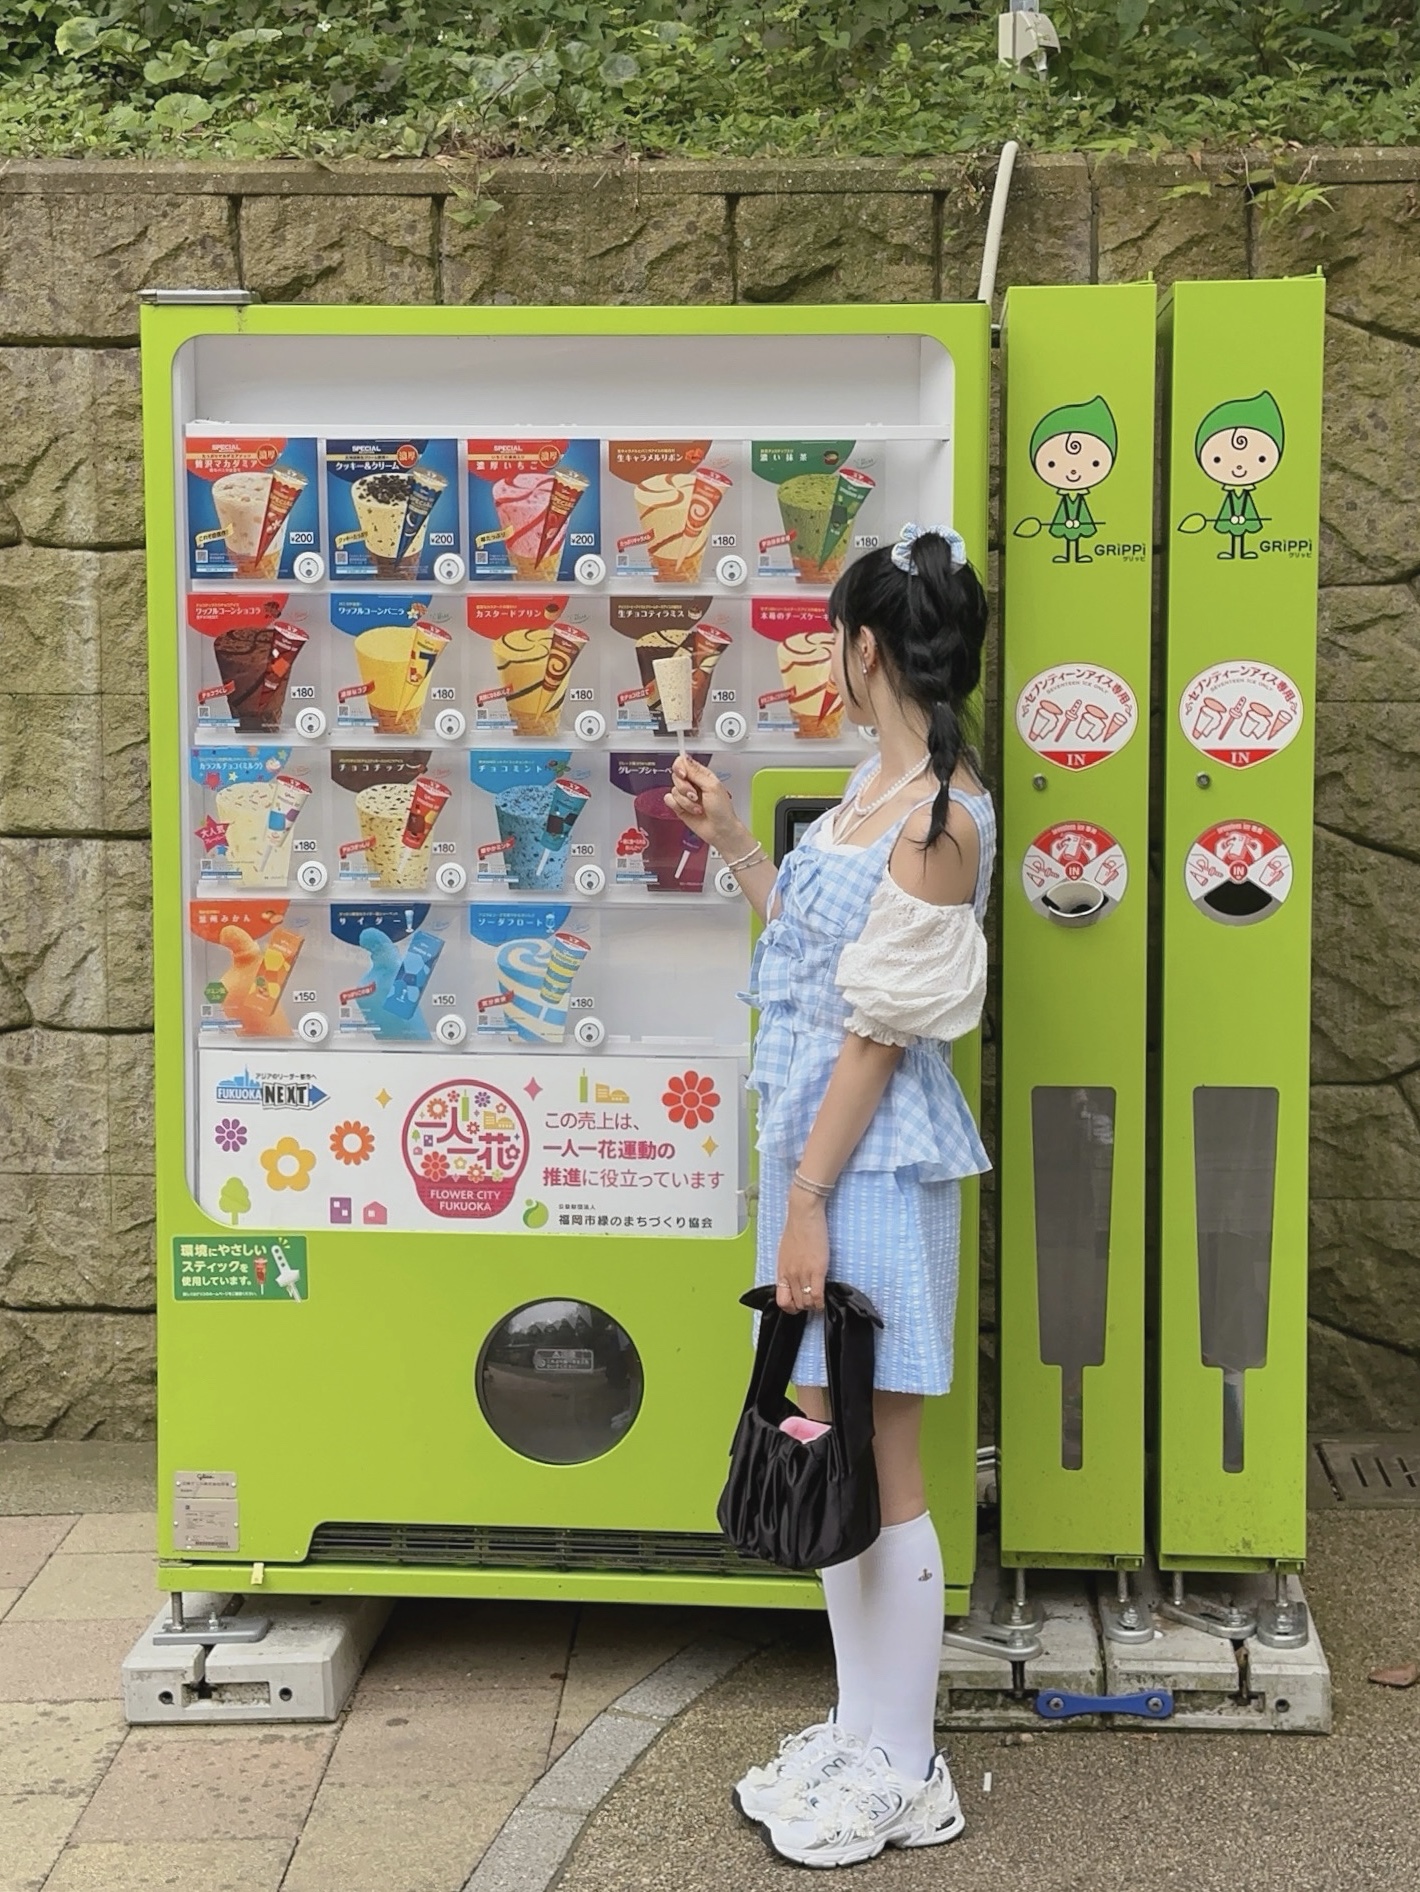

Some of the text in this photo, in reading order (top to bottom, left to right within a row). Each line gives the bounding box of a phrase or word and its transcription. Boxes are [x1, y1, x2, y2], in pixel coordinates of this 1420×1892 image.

[617, 454, 684, 463] 生キャラメルリボン
[760, 453, 808, 462] 濃い抹茶
[195, 459, 258, 469] 贅沢マカダミア
[335, 461, 400, 471] クッキー&クリーム
[476, 461, 538, 471] 濃厚いちご
[195, 607, 261, 616] ワッフルコーンショコラ
[338, 607, 405, 617] ワッフルコーンバニラ
[475, 609, 542, 618] カスタードプリン
[618, 610, 685, 619] 生チョコティラミス
[1067, 753, 1087, 766] IN
[1231, 751, 1250, 764] IN
[339, 764, 405, 772] チョコチップ
[479, 765, 543, 773] チョコミント
[202, 825, 225, 839] 大人気
[1068, 866, 1080, 876] IN
[1233, 866, 1245, 876] IN
[339, 916, 402, 926] サイダー
[478, 918, 543, 927] ソーダフロート
[218, 1085, 308, 1104] FUKUOKA NEXT
[545, 1111, 640, 1131] この売上は、
[543, 1138, 676, 1160] 一人一花運動の
[543, 1167, 725, 1189] 推進に役立っています
[430, 1189, 501, 1200] FLOWER CITY
[439, 1201, 492, 1211] FUKUOKA
[558, 1213, 713, 1230] 福岡市緑のまちづくり協会
[180, 1243, 267, 1258] 環境にやさしい
[181, 1260, 249, 1274] スティックを
[181, 1275, 252, 1287] 使用しています。
